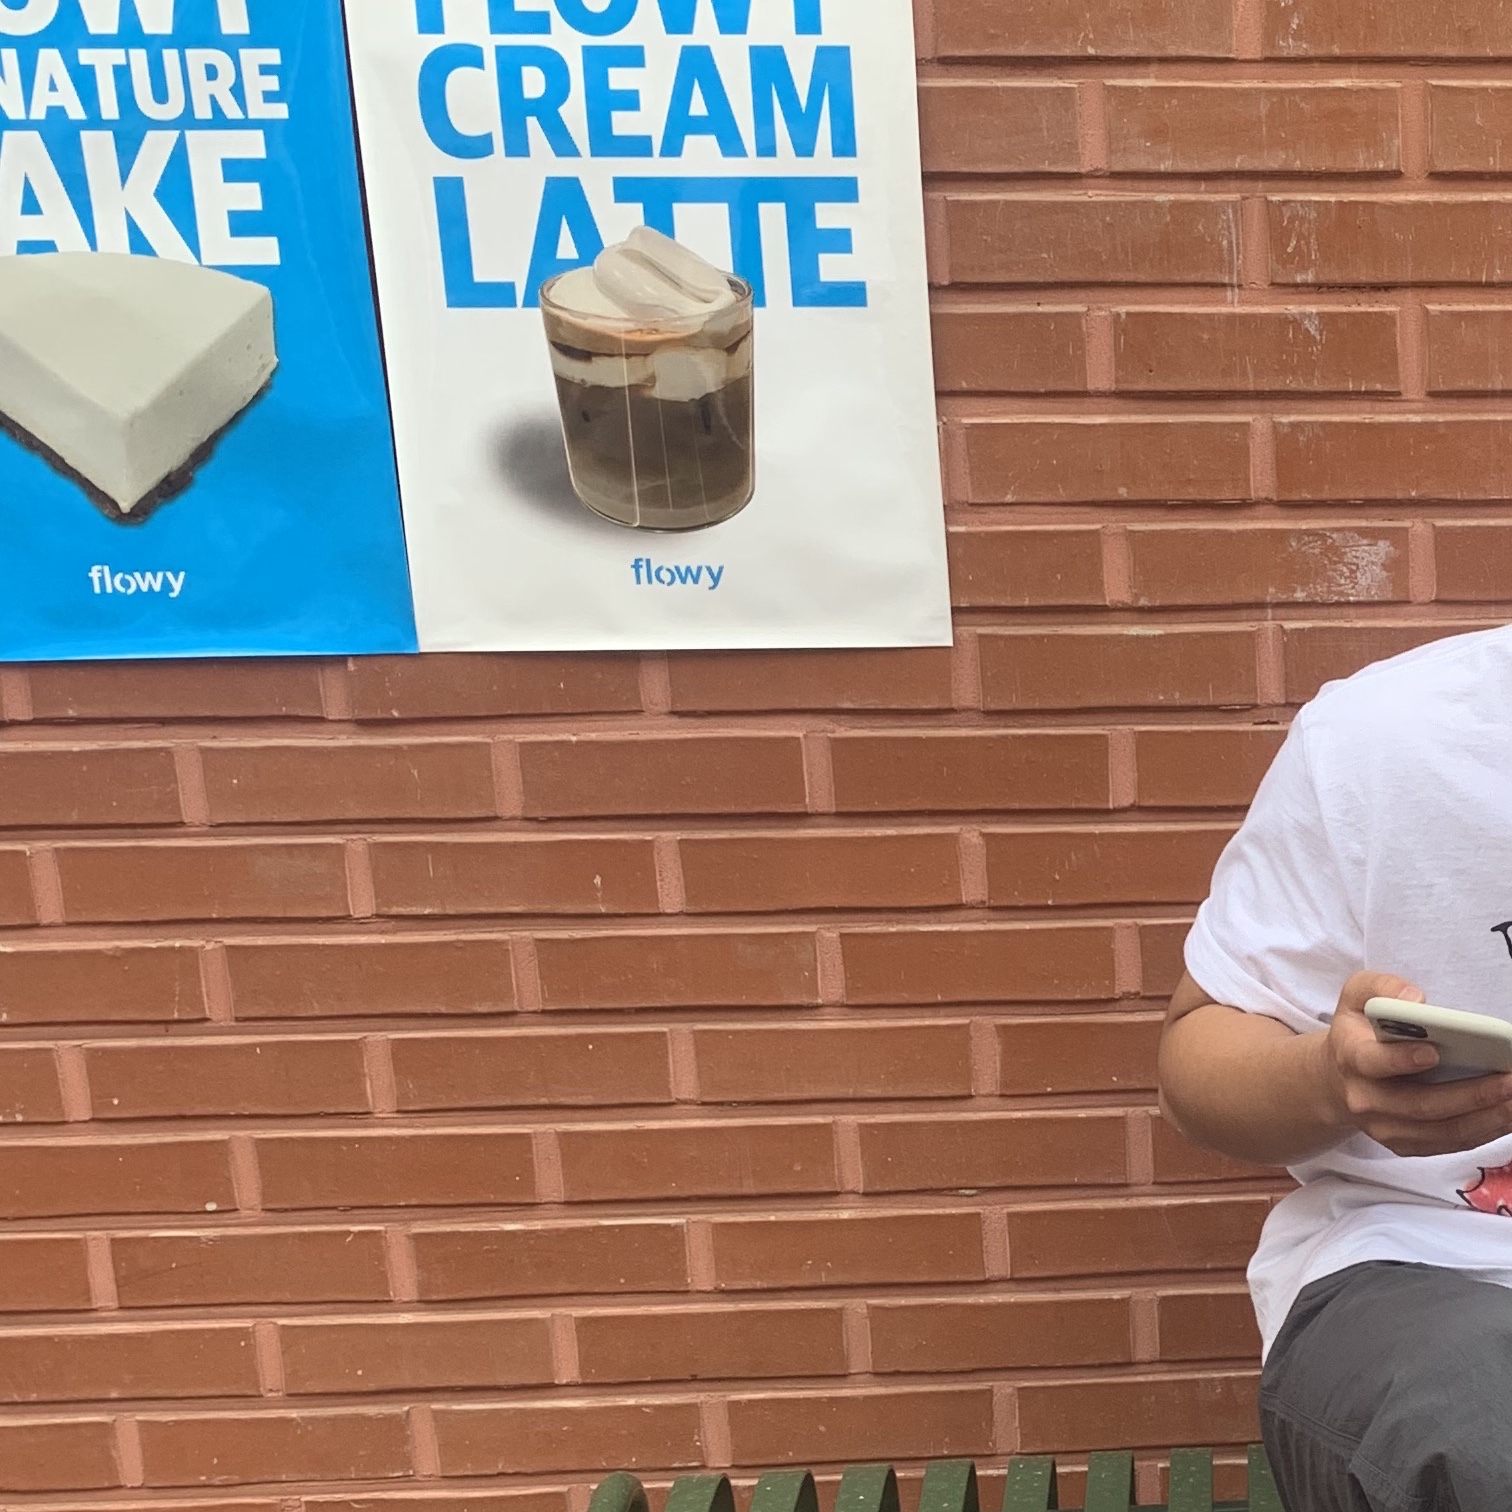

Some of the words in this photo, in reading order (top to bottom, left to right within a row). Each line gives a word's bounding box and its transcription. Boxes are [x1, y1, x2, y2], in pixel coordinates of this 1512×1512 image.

[417, 43, 858, 160] CREAM
[432, 176, 868, 309] LATTE
[88, 564, 187, 599] flowy
[630, 556, 725, 591] flowy
